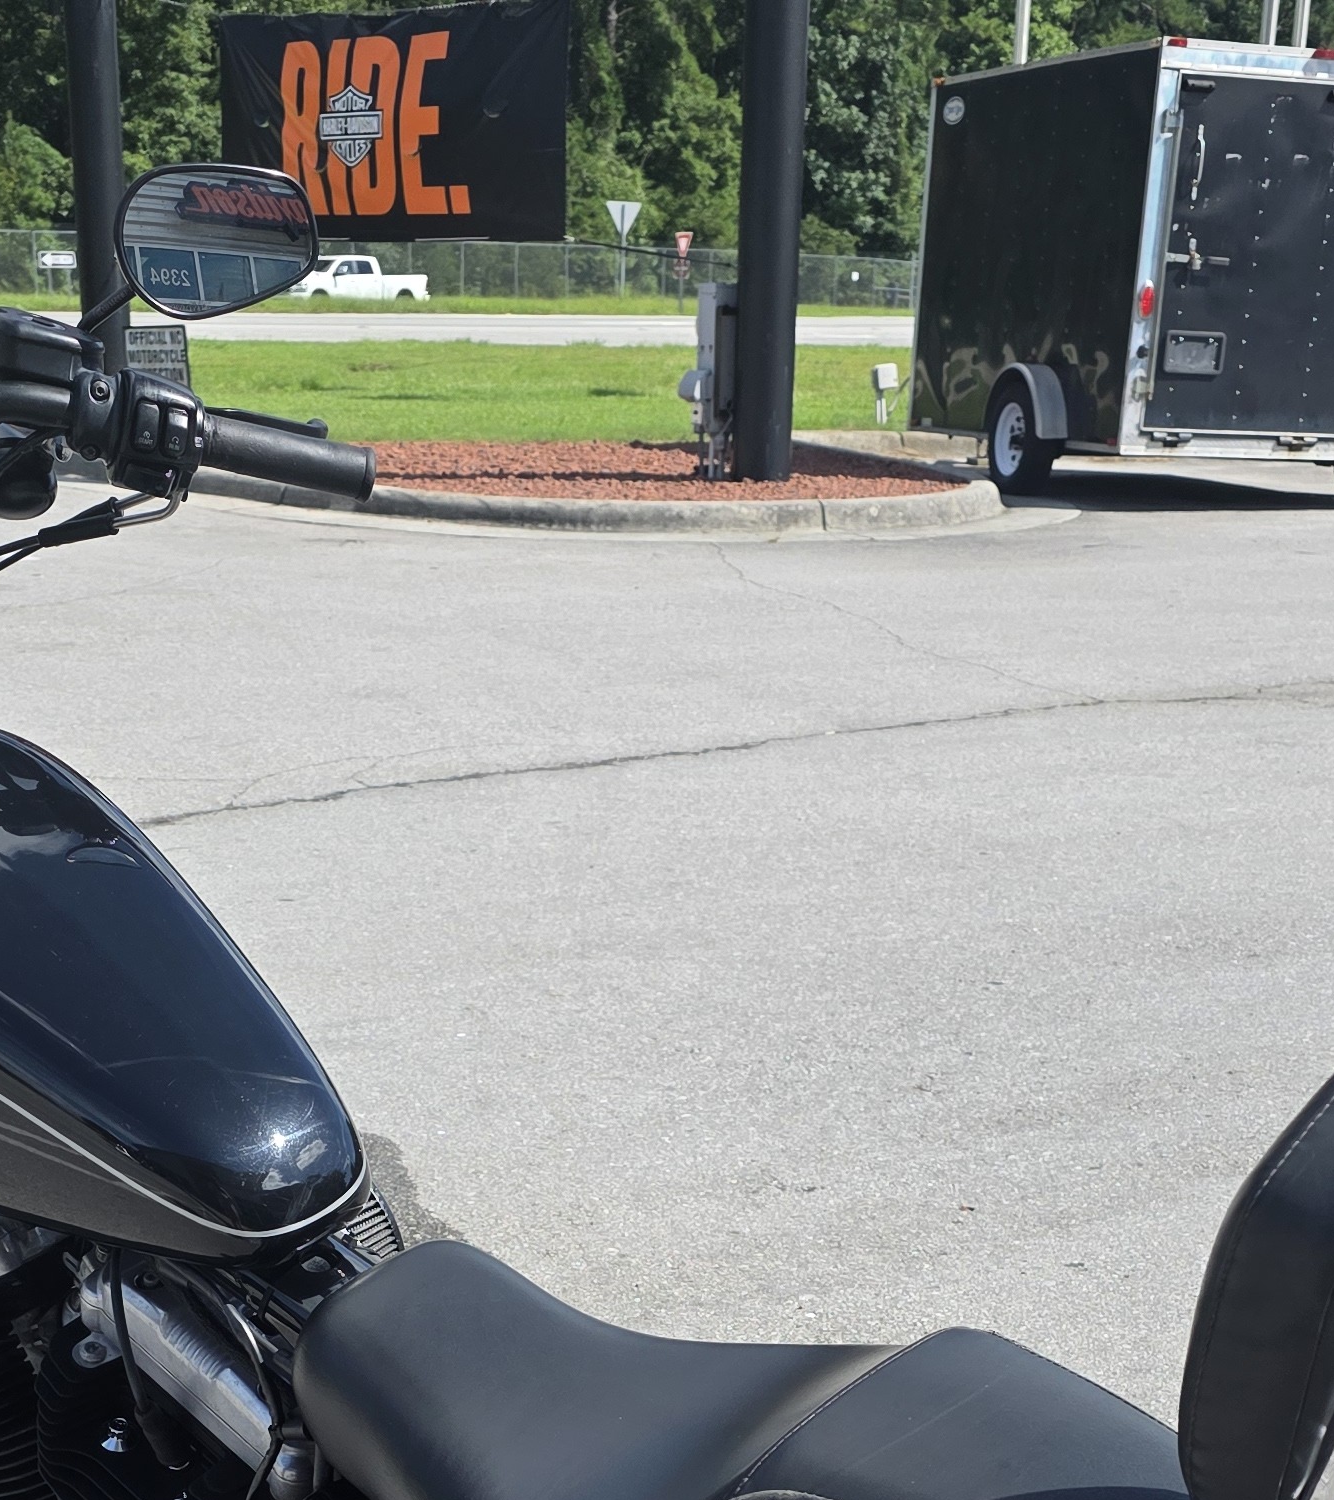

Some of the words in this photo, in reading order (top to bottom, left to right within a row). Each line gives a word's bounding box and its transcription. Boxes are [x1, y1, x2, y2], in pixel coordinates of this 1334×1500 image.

[280, 31, 472, 216] RIDE.
[129, 330, 167, 345] OFFICIAL
[128, 349, 186, 363] MOTORCYCLE
